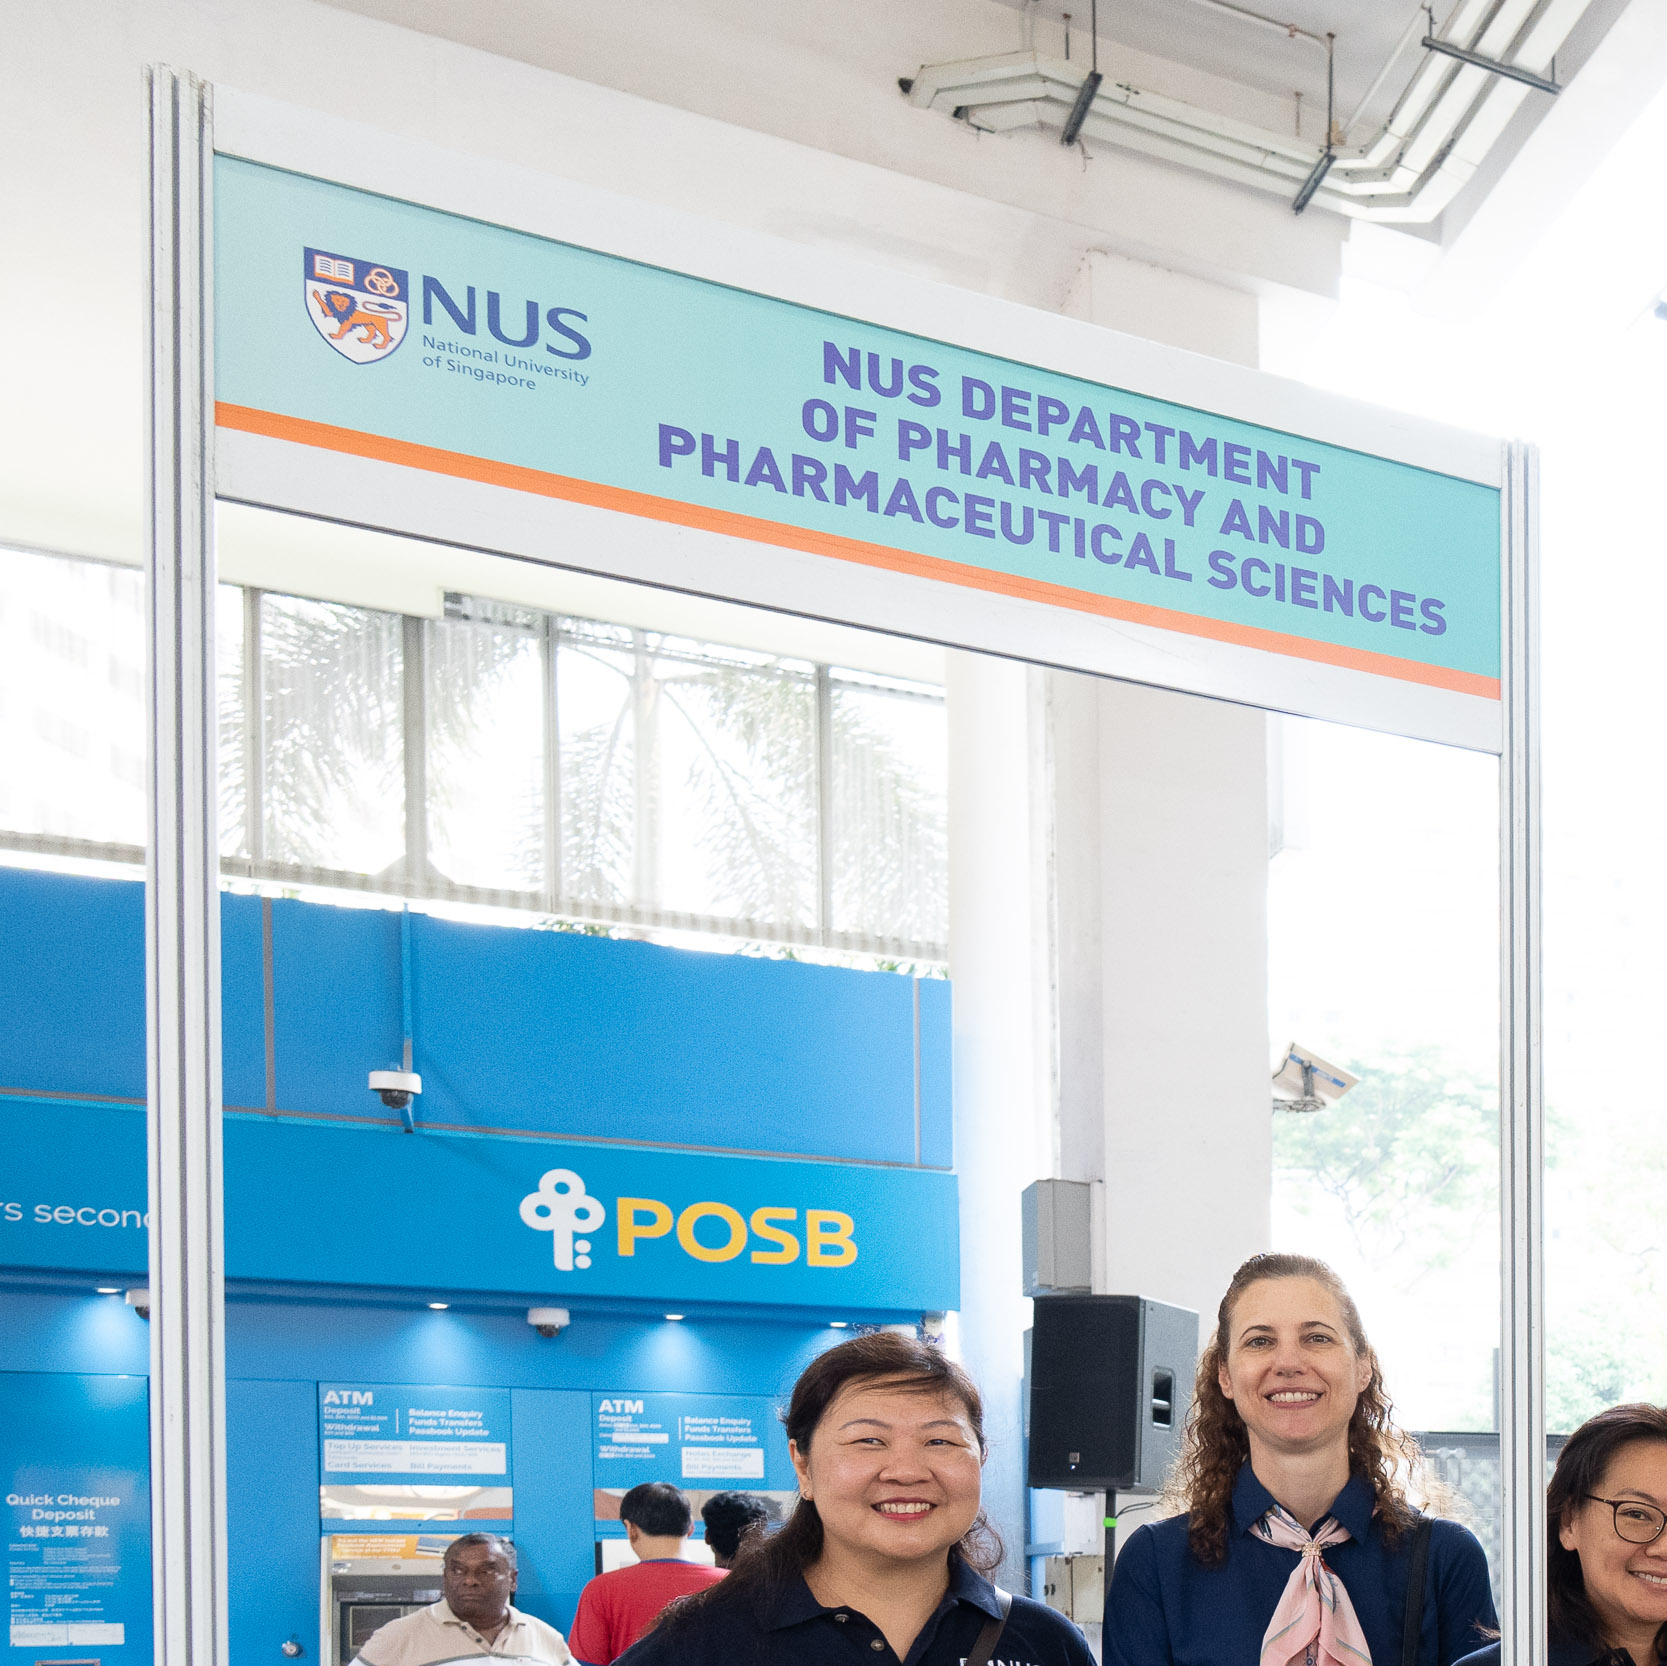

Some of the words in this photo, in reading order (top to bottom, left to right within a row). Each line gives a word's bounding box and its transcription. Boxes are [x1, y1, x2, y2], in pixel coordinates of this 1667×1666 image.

[422, 274, 592, 361] NUS
[422, 335, 499, 364] National
[504, 354, 590, 387] University
[422, 355, 442, 368] of
[447, 359, 537, 390] Singapore
[822, 340, 941, 408] NUS
[962, 375, 1321, 502] DEPARTMENT
[801, 398, 878, 448] OF
[898, 419, 1207, 524] PHARMACY
[1219, 497, 1326, 555] AND
[657, 422, 1193, 583] PHARMACEUTICAL
[1206, 550, 1447, 637] SCIENCES
[617, 1197, 858, 1267] POSB
[324, 1390, 374, 1406] ATM
[324, 1407, 361, 1416] Deposit
[408, 1408, 447, 1417] Balance
[448, 1409, 483, 1420] Enquiry
[599, 1399, 644, 1414] ATM
[408, 1418, 438, 1426] Funds
[440, 1418, 483, 1427] Transfers
[599, 1415, 632, 1423] Deposit
[684, 1416, 718, 1425] Balance
[720, 1418, 751, 1427] Enquiry
[324, 1423, 380, 1433] Withdrawal
[408, 1427, 453, 1436] Passbook
[455, 1428, 490, 1437] Update
[684, 1425, 711, 1433] Funds
[712, 1426, 751, 1434] Transfers
[684, 1434, 725, 1442] Passbook
[726, 1435, 758, 1443] Update
[6, 1493, 55, 1506] Quick
[57, 1494, 121, 1508] Cheque
[32, 1508, 96, 1523] Deposit
